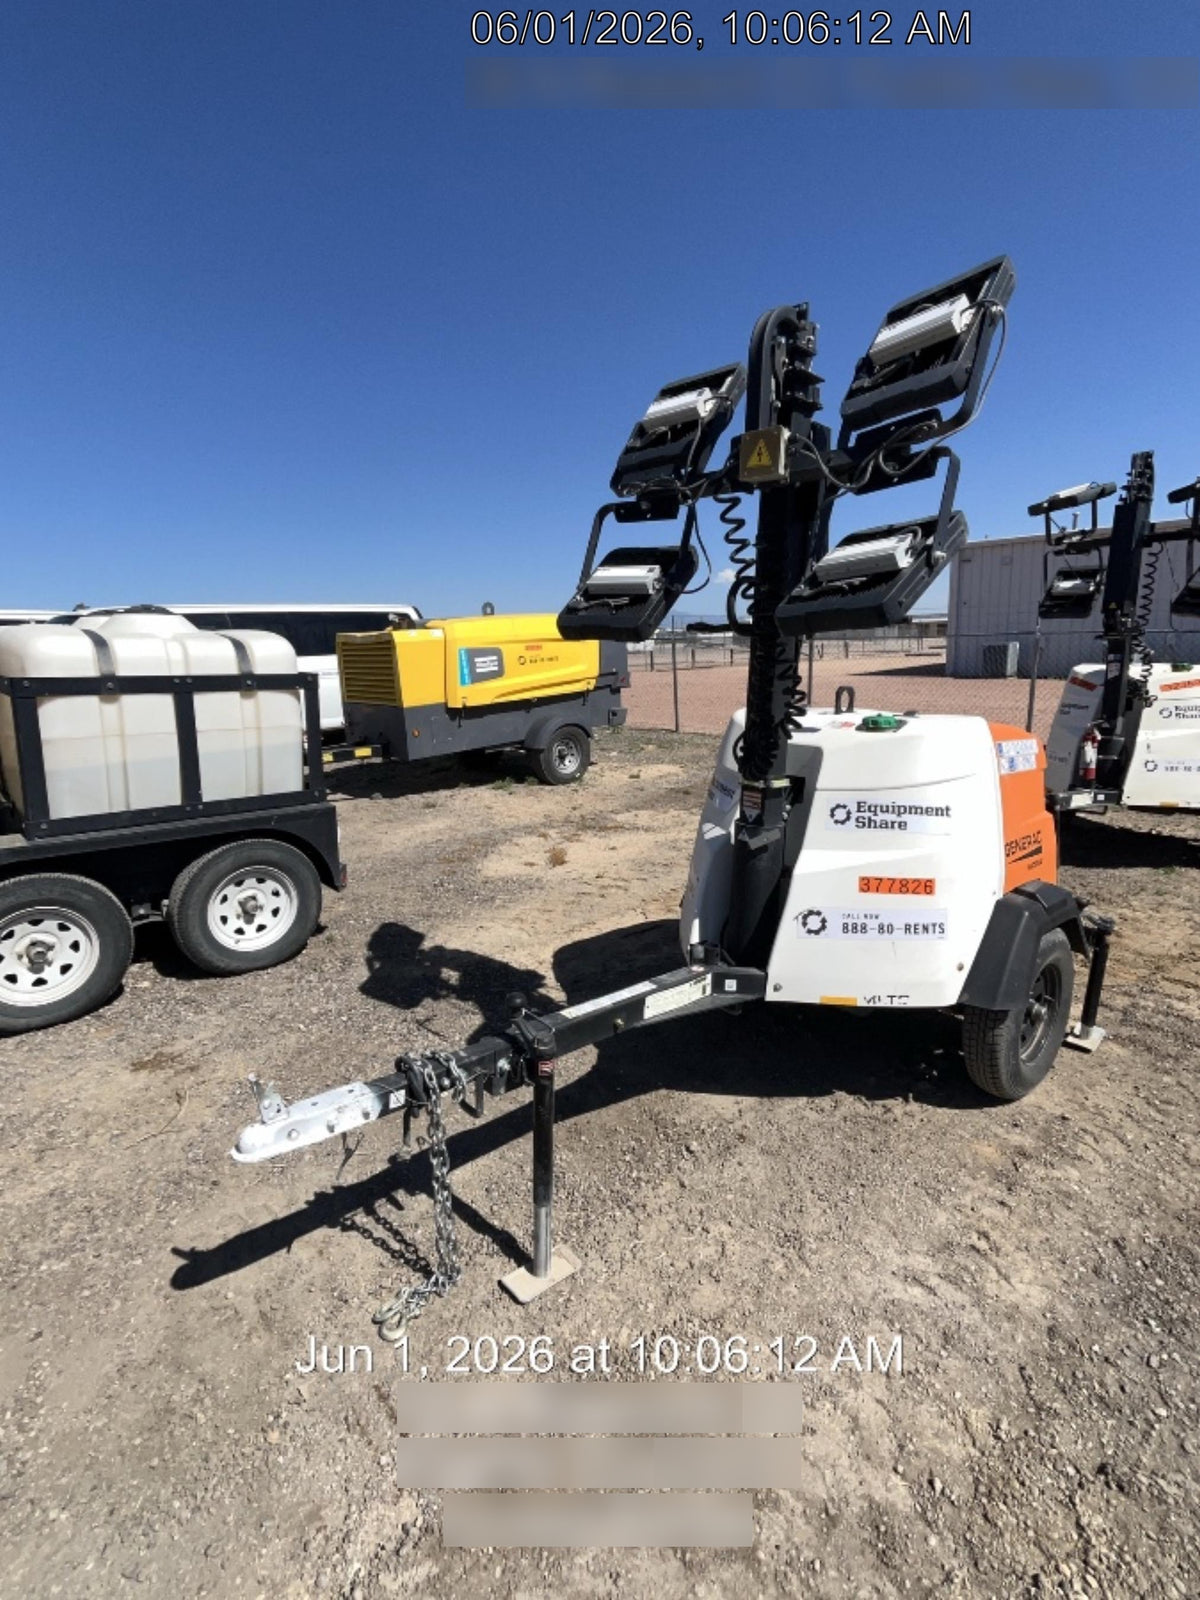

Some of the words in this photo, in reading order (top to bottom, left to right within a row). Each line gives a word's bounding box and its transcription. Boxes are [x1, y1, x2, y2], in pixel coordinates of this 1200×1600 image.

[855, 801, 952, 818] Equipment
[855, 816, 908, 831] Share
[1004, 830, 1042, 858] GENERAC
[859, 877, 935, 895] 377826
[841, 921, 946, 936] 888-80-RENTS
